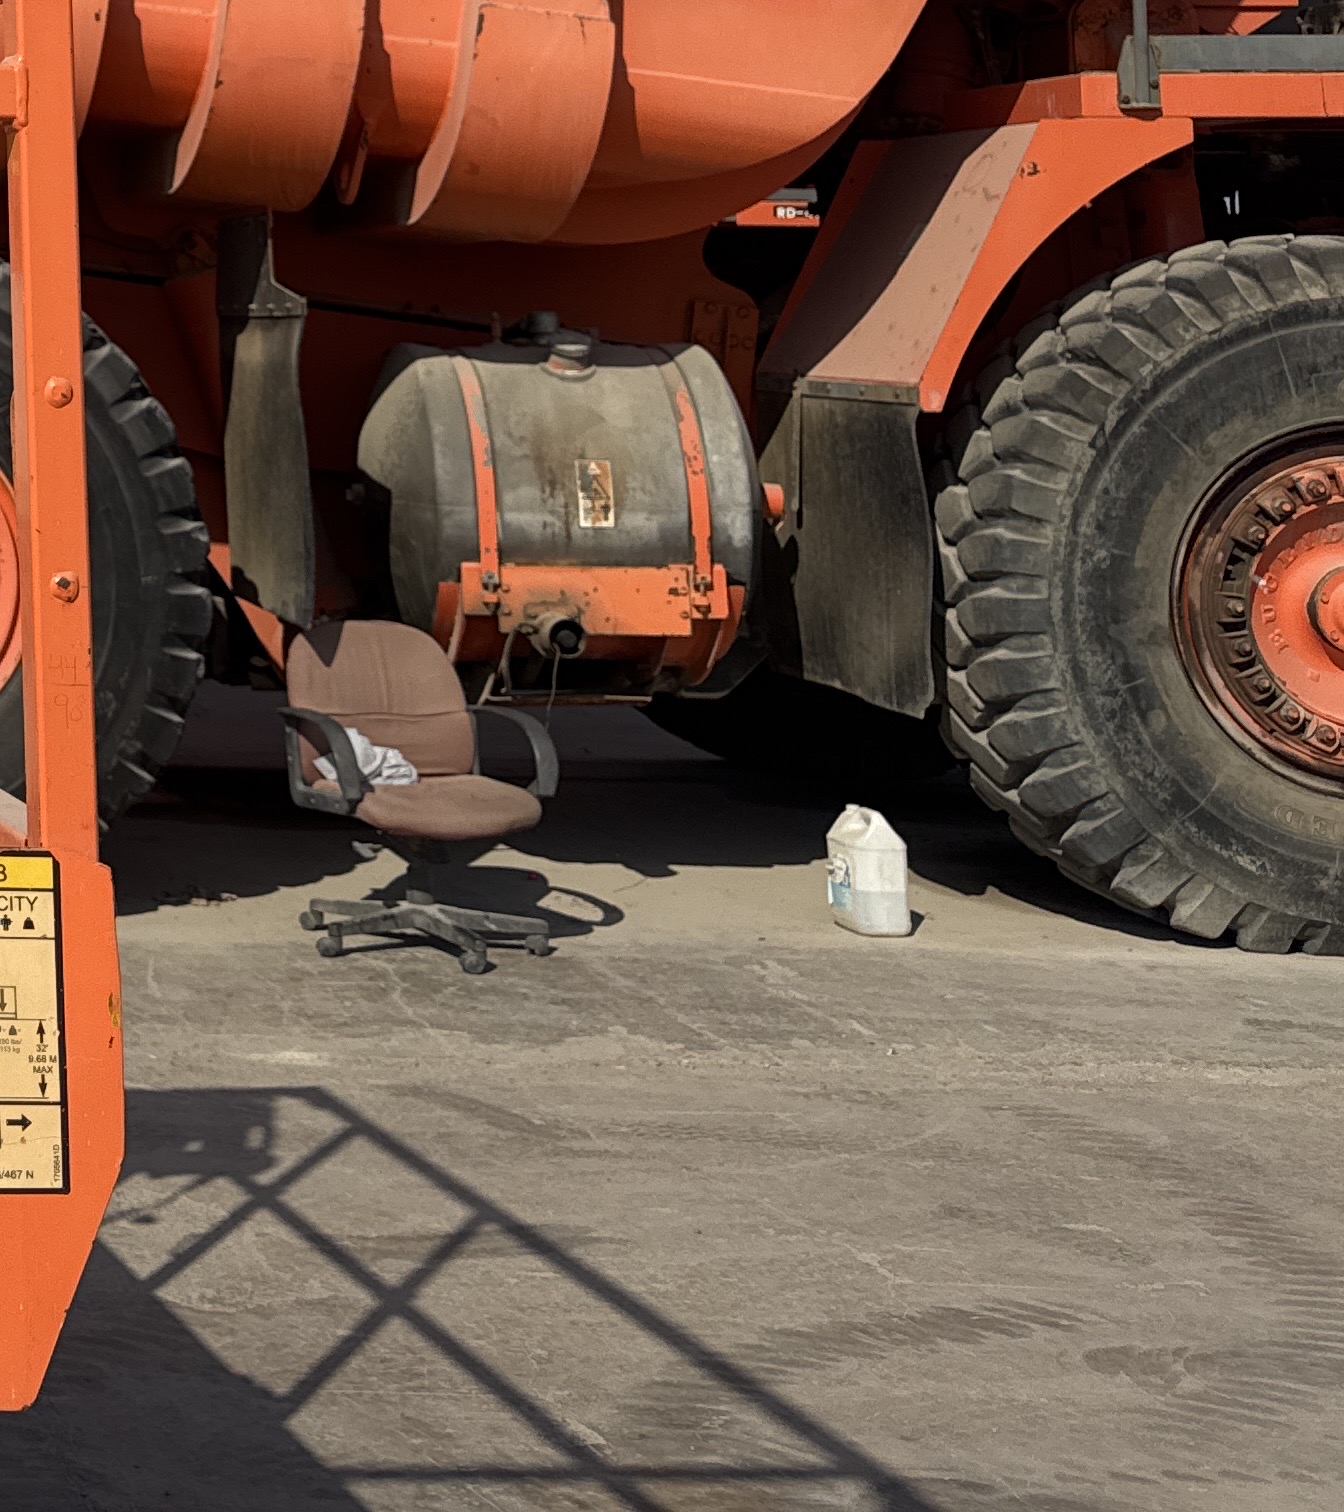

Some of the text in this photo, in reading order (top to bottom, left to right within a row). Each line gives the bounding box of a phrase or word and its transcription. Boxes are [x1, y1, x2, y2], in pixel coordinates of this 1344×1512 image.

[49, 1054, 57, 1063] M
[32, 1065, 54, 1074] MAX
[26, 1170, 34, 1180] N
